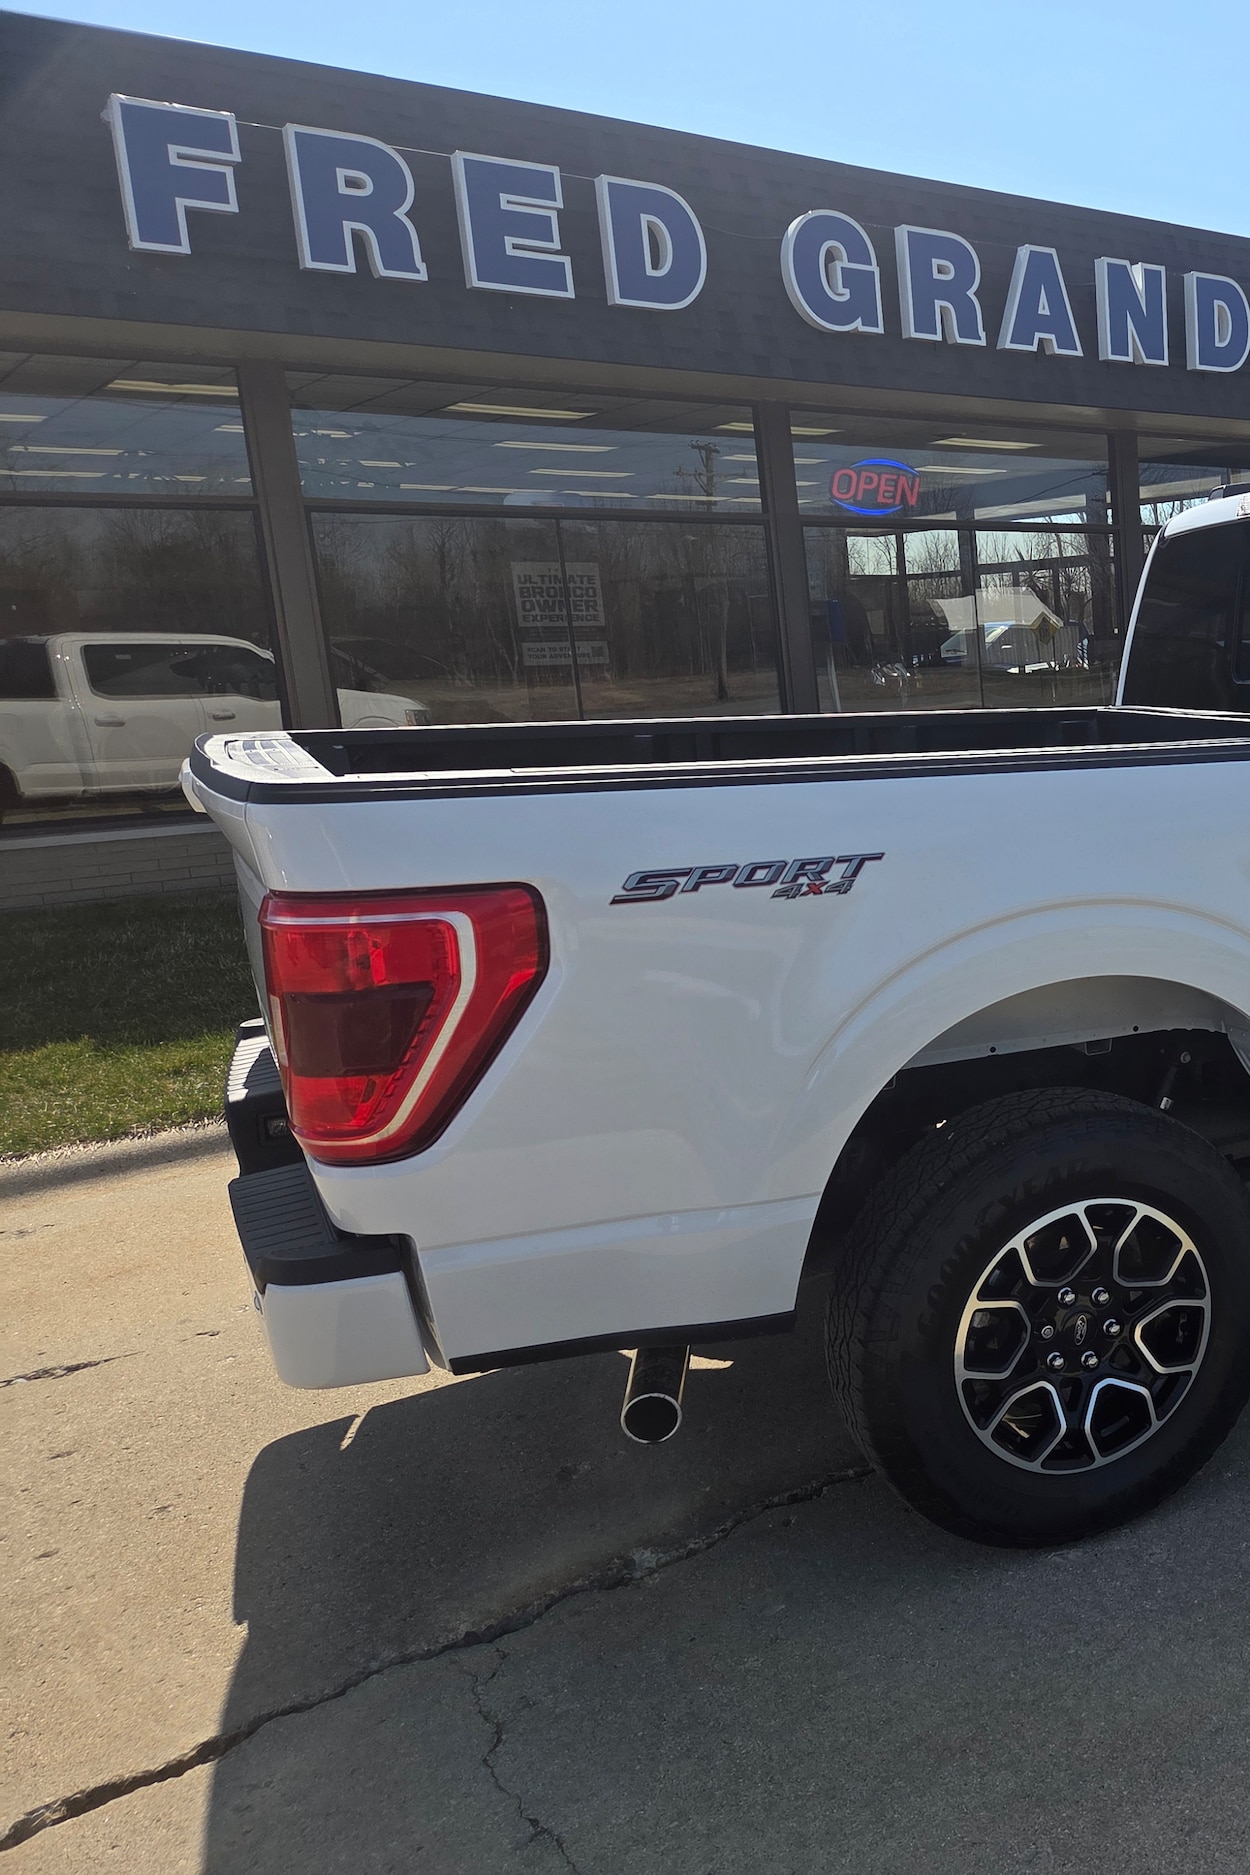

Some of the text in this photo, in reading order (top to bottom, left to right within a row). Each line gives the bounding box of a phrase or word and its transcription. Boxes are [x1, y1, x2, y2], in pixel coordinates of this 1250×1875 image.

[105, 93, 708, 312] FRED
[831, 466, 921, 509] OPEN
[517, 574, 597, 585] ULTIMATE
[518, 586, 598, 599] BRONCO
[520, 599, 598, 612] OWNER
[609, 852, 886, 905] SPORT
